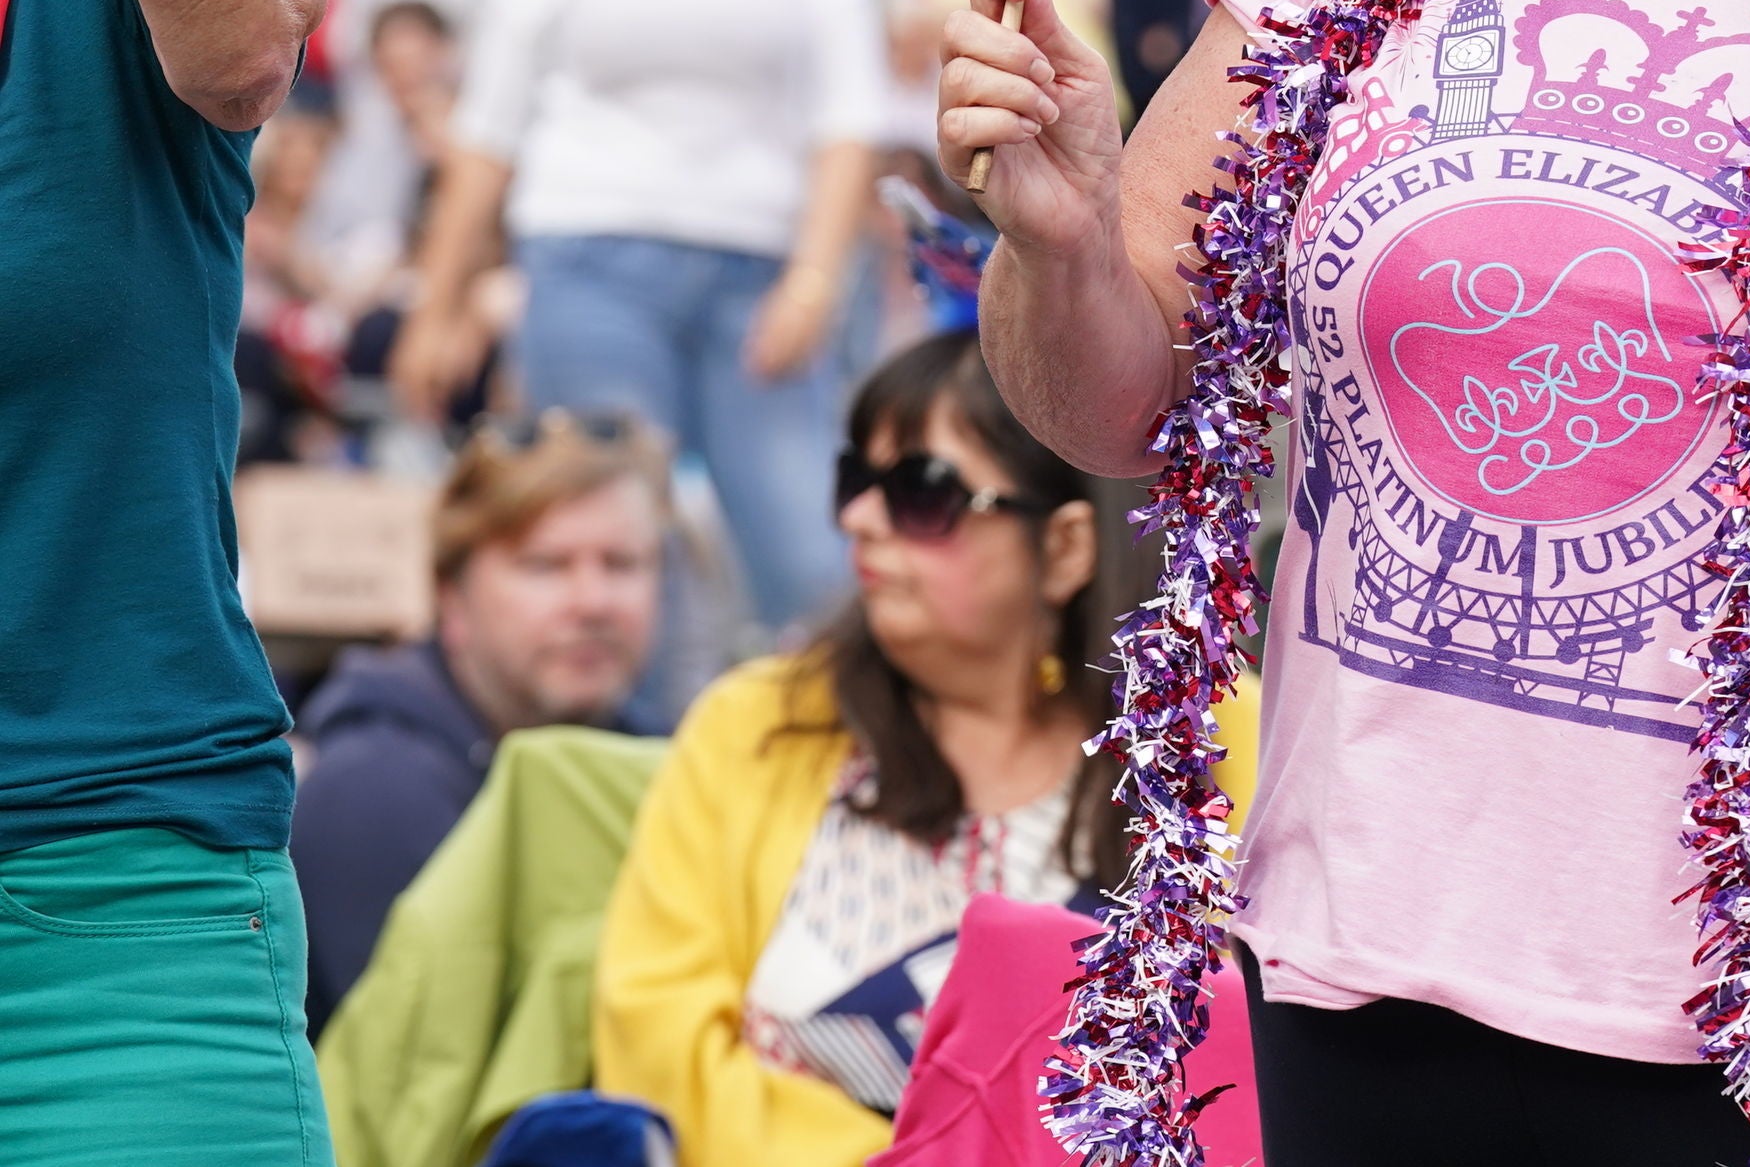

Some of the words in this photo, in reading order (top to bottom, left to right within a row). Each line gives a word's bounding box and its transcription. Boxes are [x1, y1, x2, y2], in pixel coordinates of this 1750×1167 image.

[1314, 150, 1475, 291] QUEEN
[1312, 304, 1345, 363] 52
[1331, 369, 1532, 578] PLATINUM
